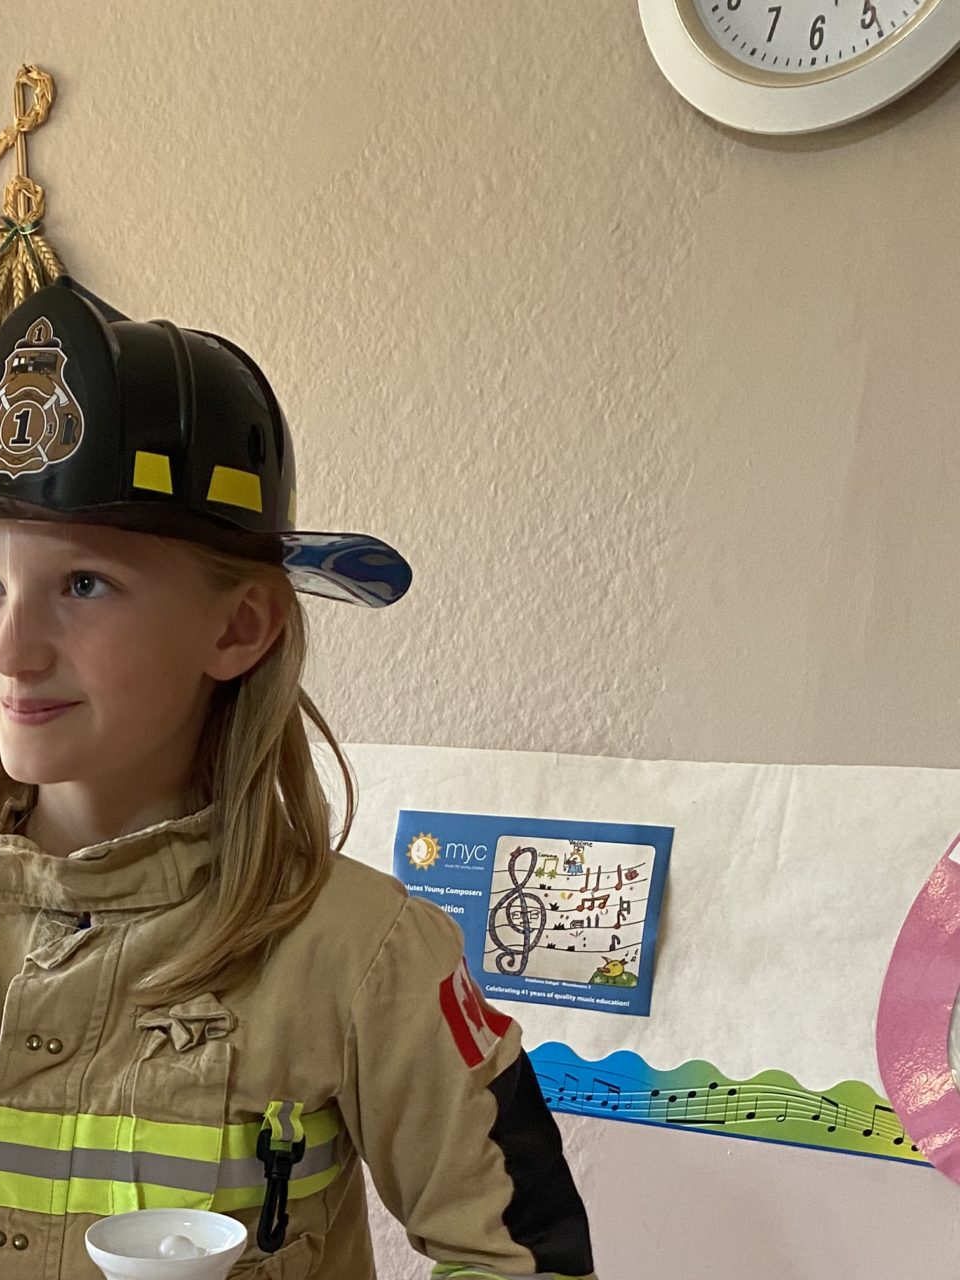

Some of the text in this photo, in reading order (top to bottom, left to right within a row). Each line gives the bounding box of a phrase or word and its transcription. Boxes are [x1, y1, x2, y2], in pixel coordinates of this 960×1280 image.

[766, 6, 782, 43] 7
[809, 14, 826, 51] 6
[32, 325, 44, 343] 1
[9, 408, 32, 447] 1
[445, 842, 488, 864] myc
[424, 885, 445, 895] Young
[445, 887, 483, 897] Composers
[485, 985, 520, 995] Celebrating
